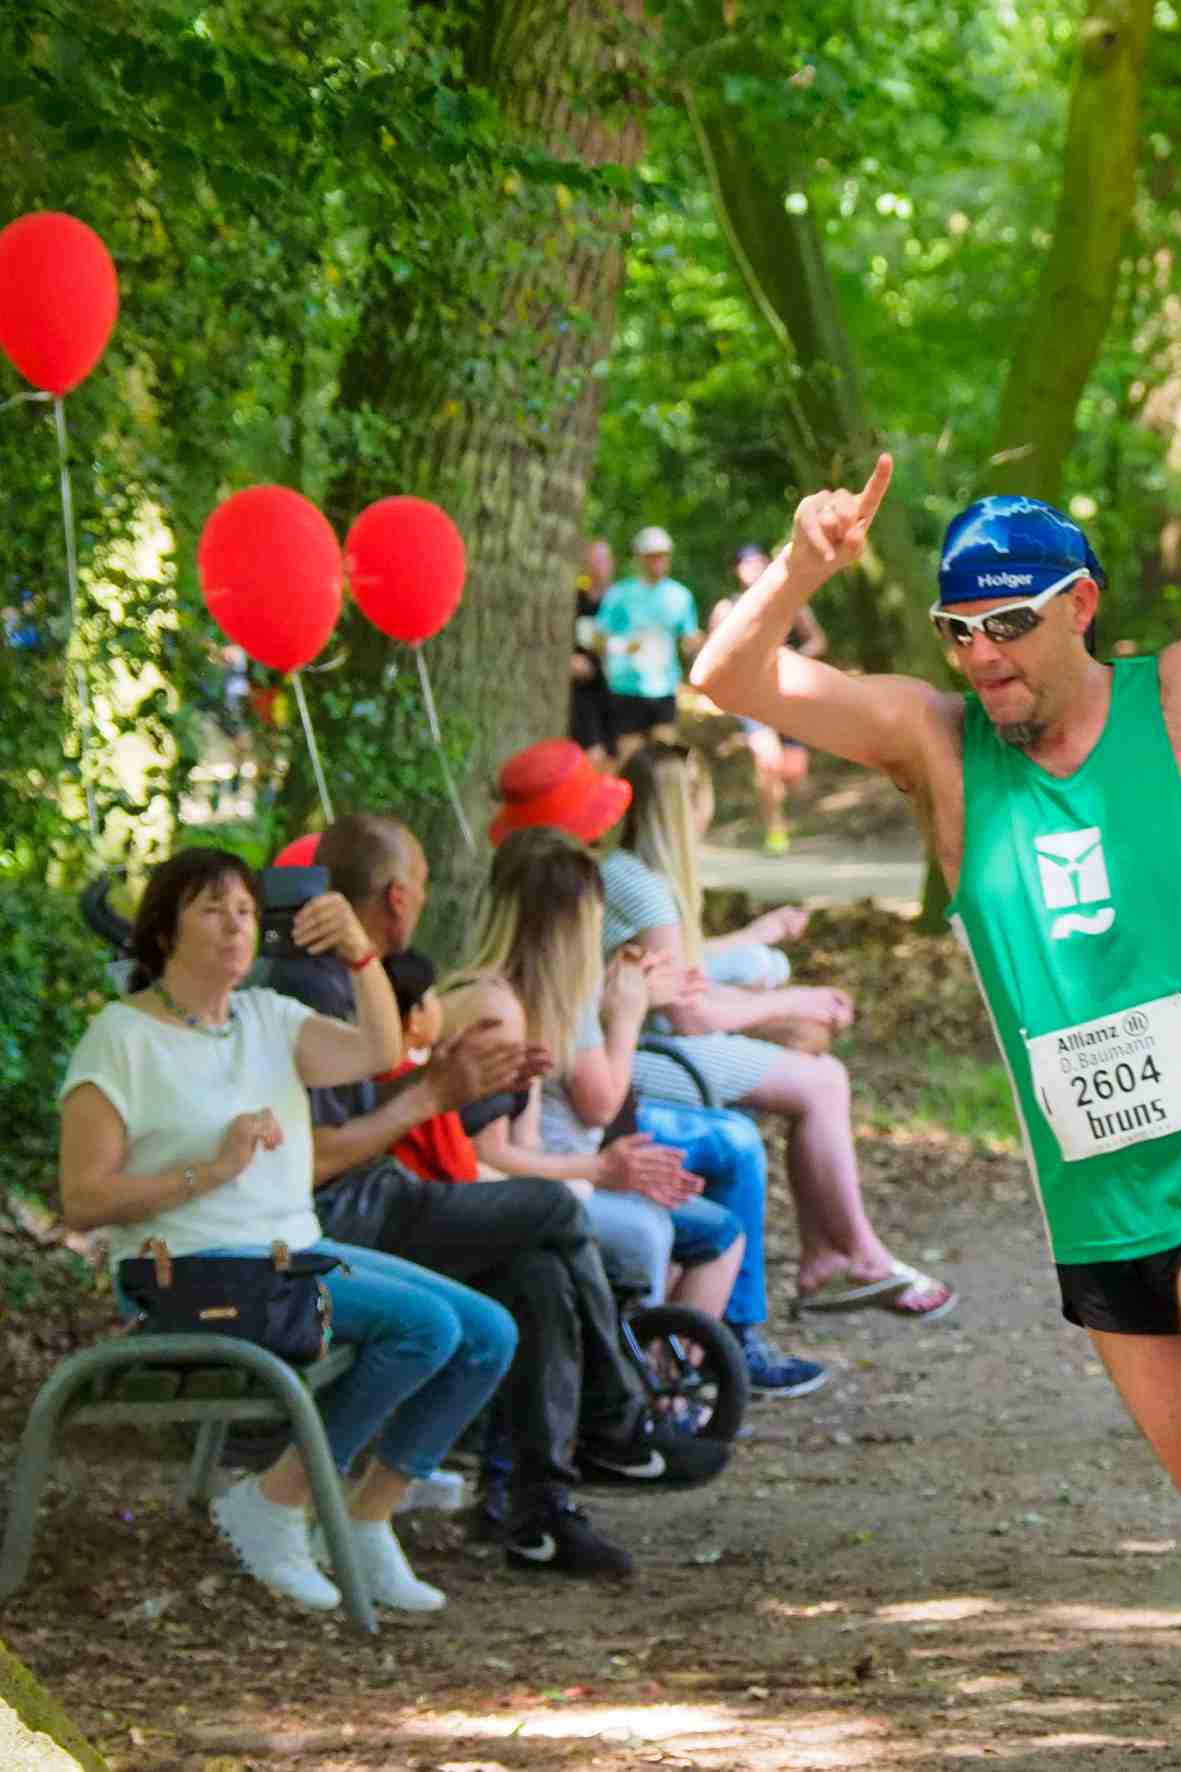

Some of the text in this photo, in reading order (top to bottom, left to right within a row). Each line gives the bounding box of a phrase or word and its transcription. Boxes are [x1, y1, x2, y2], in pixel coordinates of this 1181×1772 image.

[977, 572, 1034, 589] Holger
[1057, 1025, 1120, 1054] Allianz
[1079, 1036, 1156, 1070] Baumann
[1071, 1054, 1162, 1107] 2604
[1086, 1099, 1168, 1140] bruns
